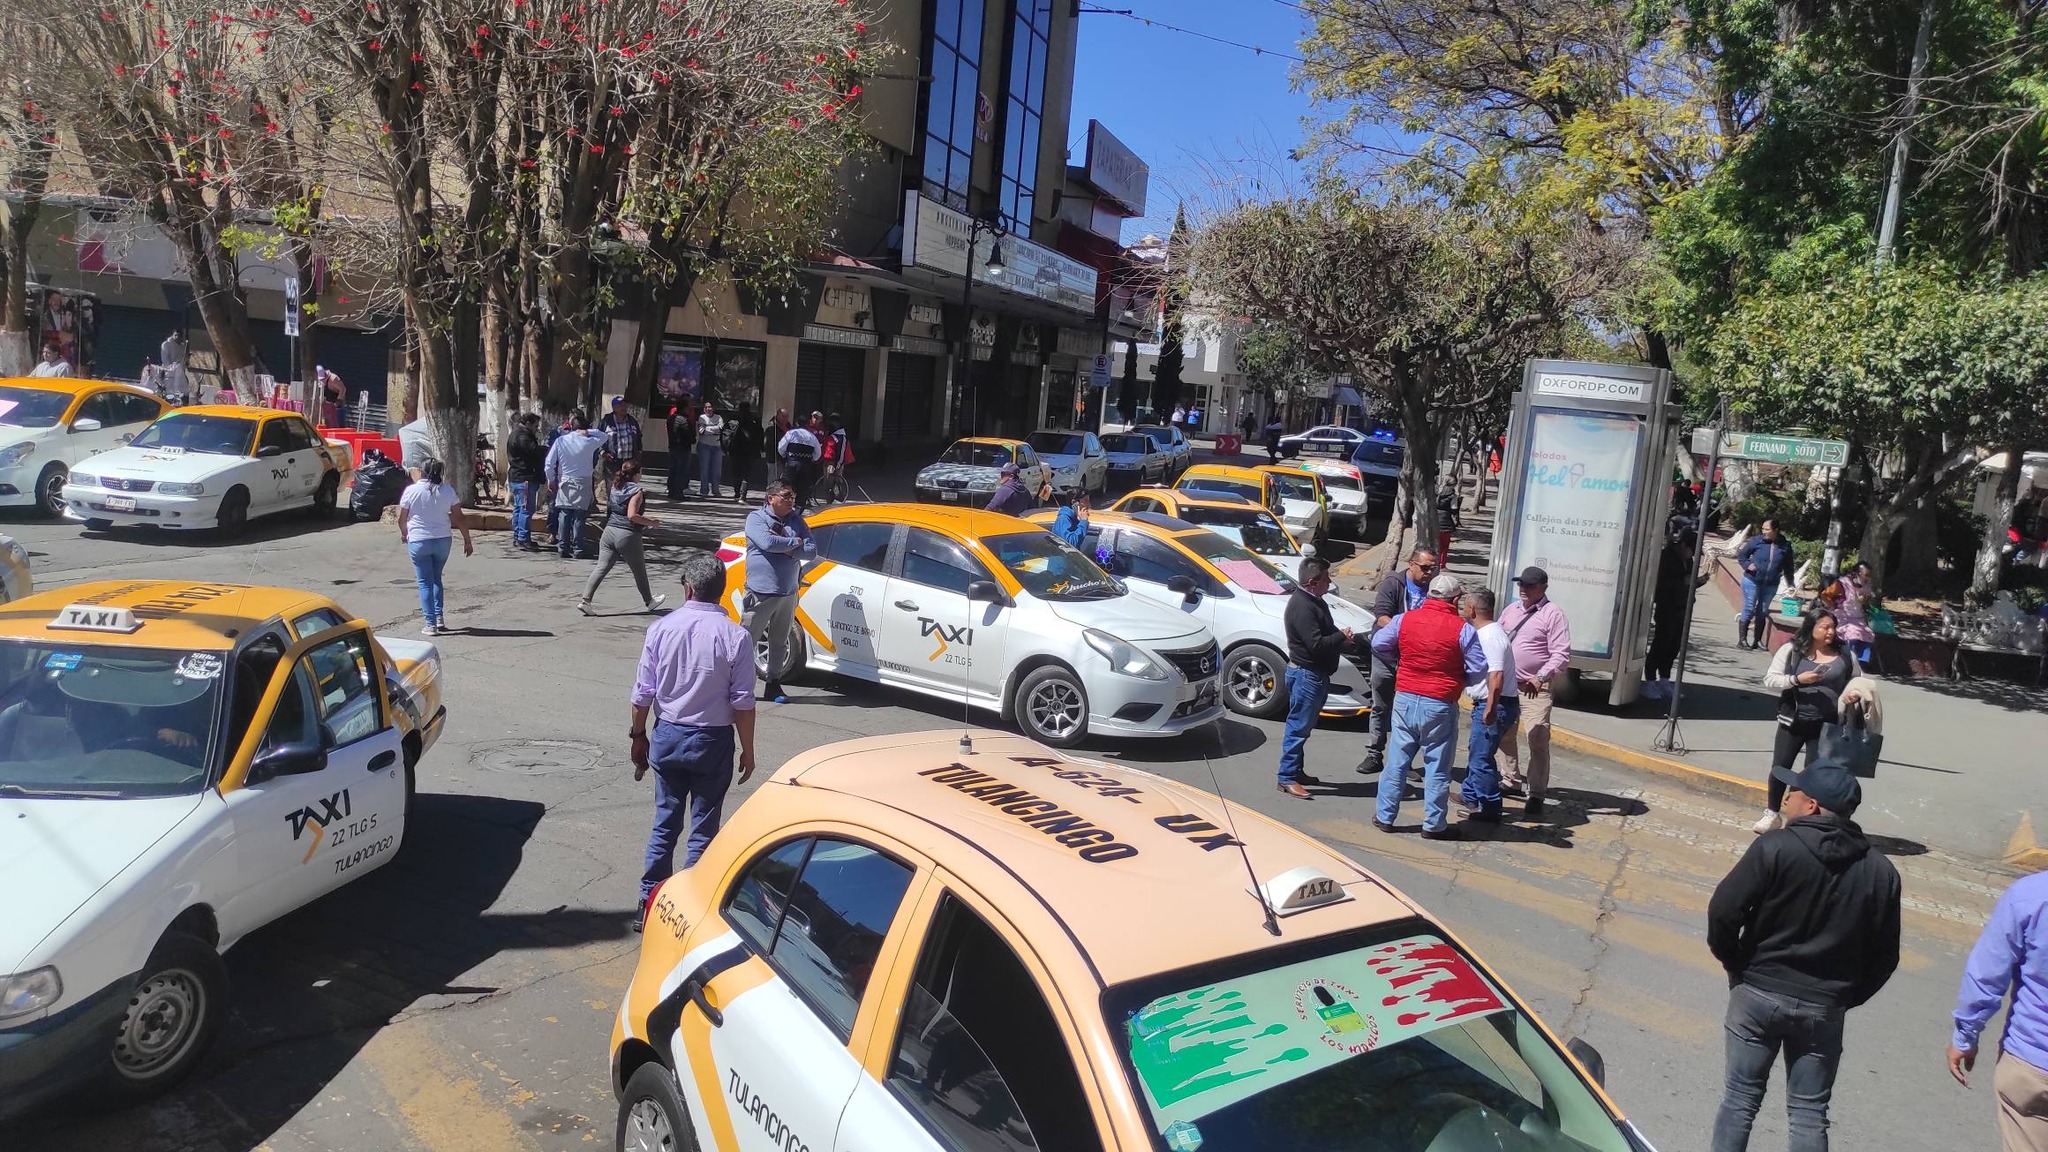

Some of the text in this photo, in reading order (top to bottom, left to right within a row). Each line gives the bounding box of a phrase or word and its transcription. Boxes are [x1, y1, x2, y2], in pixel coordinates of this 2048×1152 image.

[1542, 378, 1639, 396] OXFORDP.COM
[1794, 444, 1817, 457] SOTO
[271, 468, 289, 480] TAXI
[1526, 513, 1562, 525] Callejón
[1564, 517, 1580, 526] del
[1581, 519, 1594, 527] 57
[1540, 526, 1601, 539] Col. San Luis
[849, 585, 864, 596] SITIO
[69, 611, 118, 627] TAXI
[854, 624, 861, 635] DE
[917, 616, 974, 646] TAXI
[944, 653, 953, 664] 22
[284, 788, 351, 841] TAXI
[916, 762, 1140, 864] TULANCINGO
[331, 828, 345, 848] 22
[334, 835, 394, 875] TULANCINGO
[1298, 879, 1334, 900] TAXI
[1319, 1014, 1379, 1054] LOS HIDALGOS
